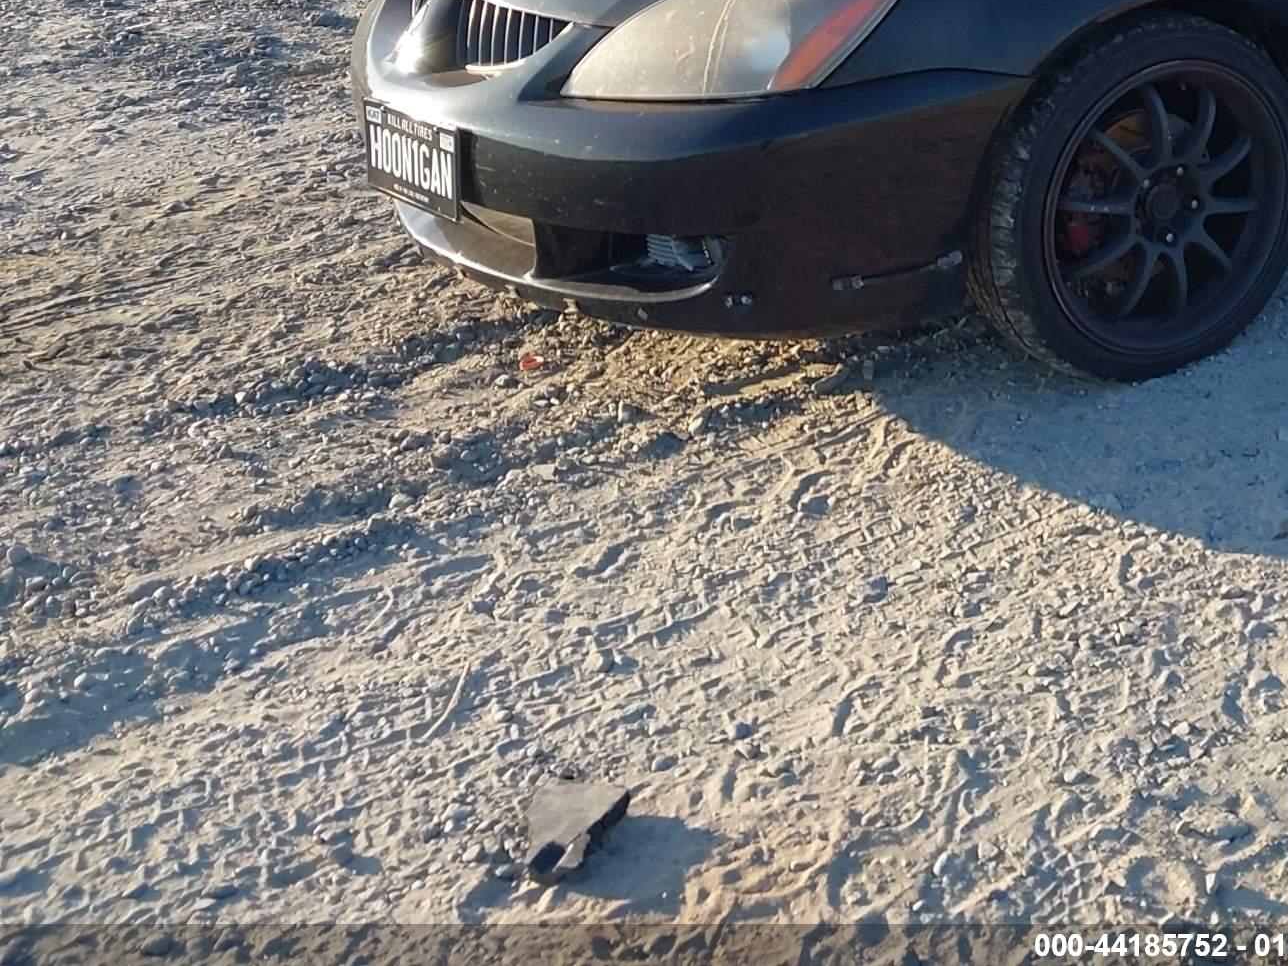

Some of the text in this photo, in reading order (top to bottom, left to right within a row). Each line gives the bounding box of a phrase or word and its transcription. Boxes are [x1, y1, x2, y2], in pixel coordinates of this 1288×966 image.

[388, 114, 432, 141] KILL ALL TIRES
[369, 124, 453, 200] HOON1GAN
